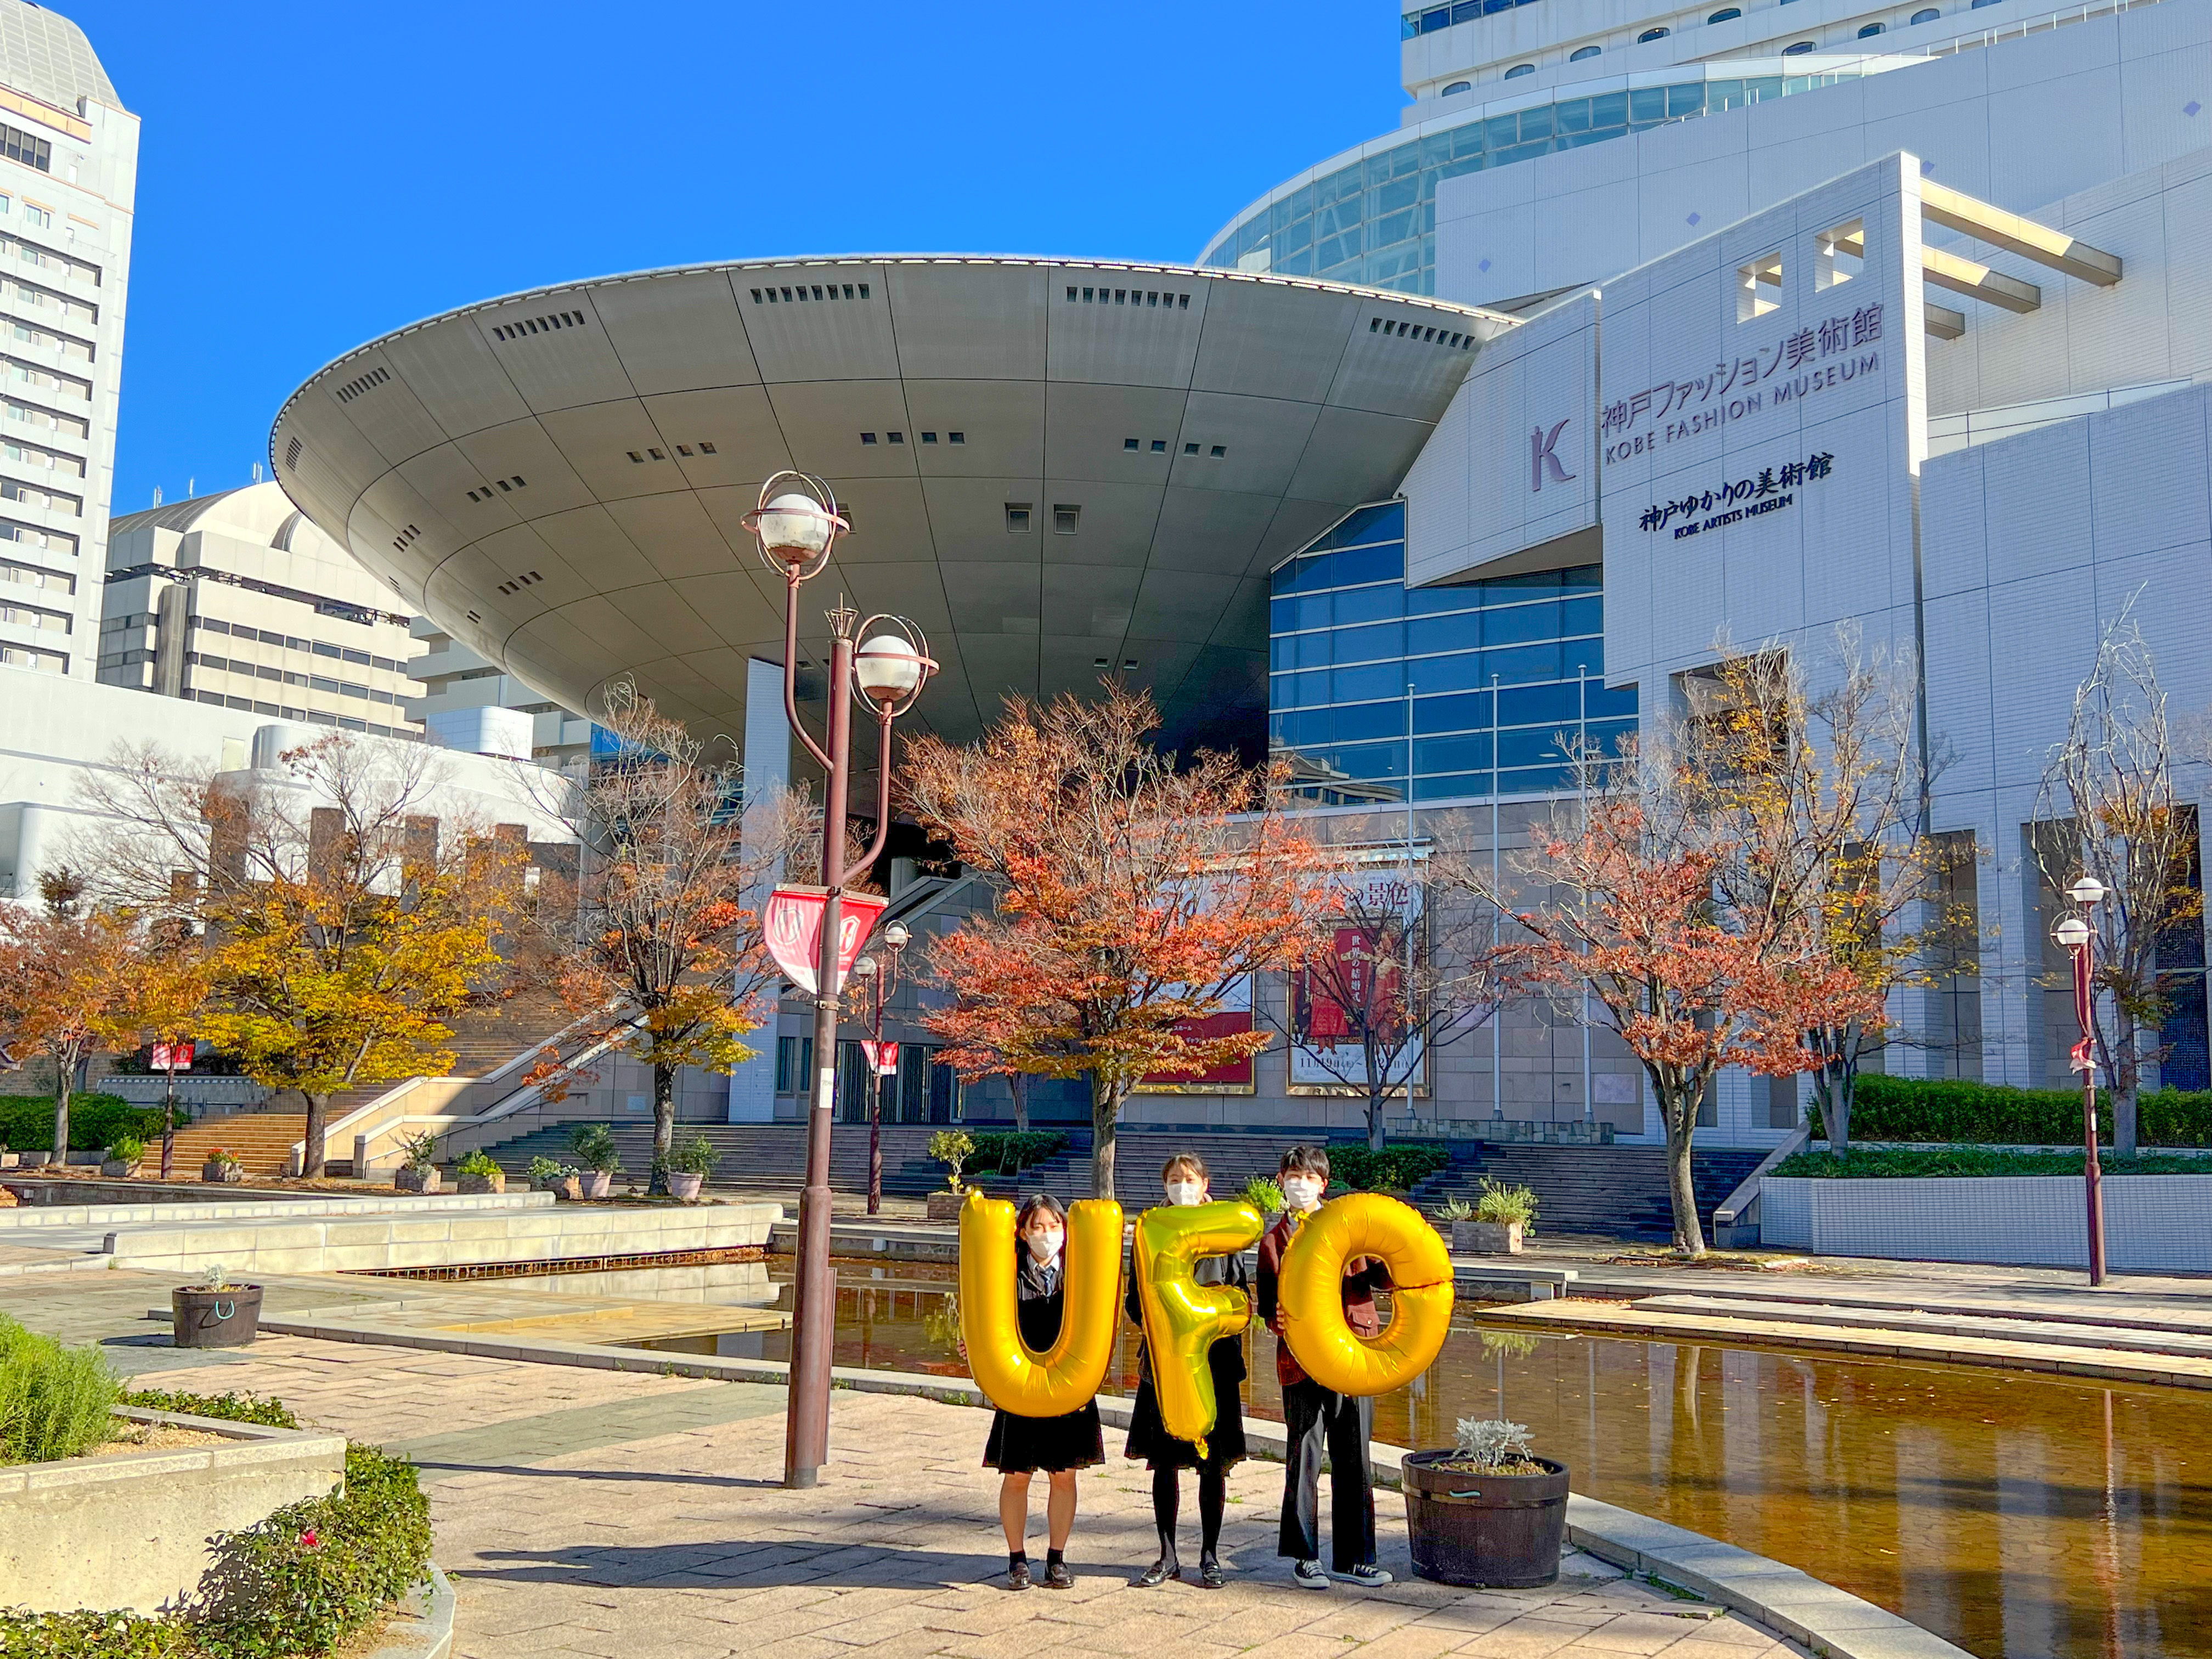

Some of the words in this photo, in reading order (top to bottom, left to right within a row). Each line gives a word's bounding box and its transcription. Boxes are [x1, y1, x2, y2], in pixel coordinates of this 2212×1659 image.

[1601, 301, 1884, 438] 神戸ファッション美術館
[1606, 431, 1655, 465] KOBE
[1665, 392, 1762, 443] FASHION
[1774, 351, 1879, 405] MUSEUM
[1530, 418, 1577, 492] K
[1639, 452, 1835, 532] 神戸ゆかりの美術館
[1674, 522, 1700, 540] KOBE
[1702, 509, 1742, 532] ARTISTS
[1745, 493, 1793, 518] MUSEUM
[1340, 881, 1409, 907] の景色
[959, 1190, 1454, 1444] UFO
